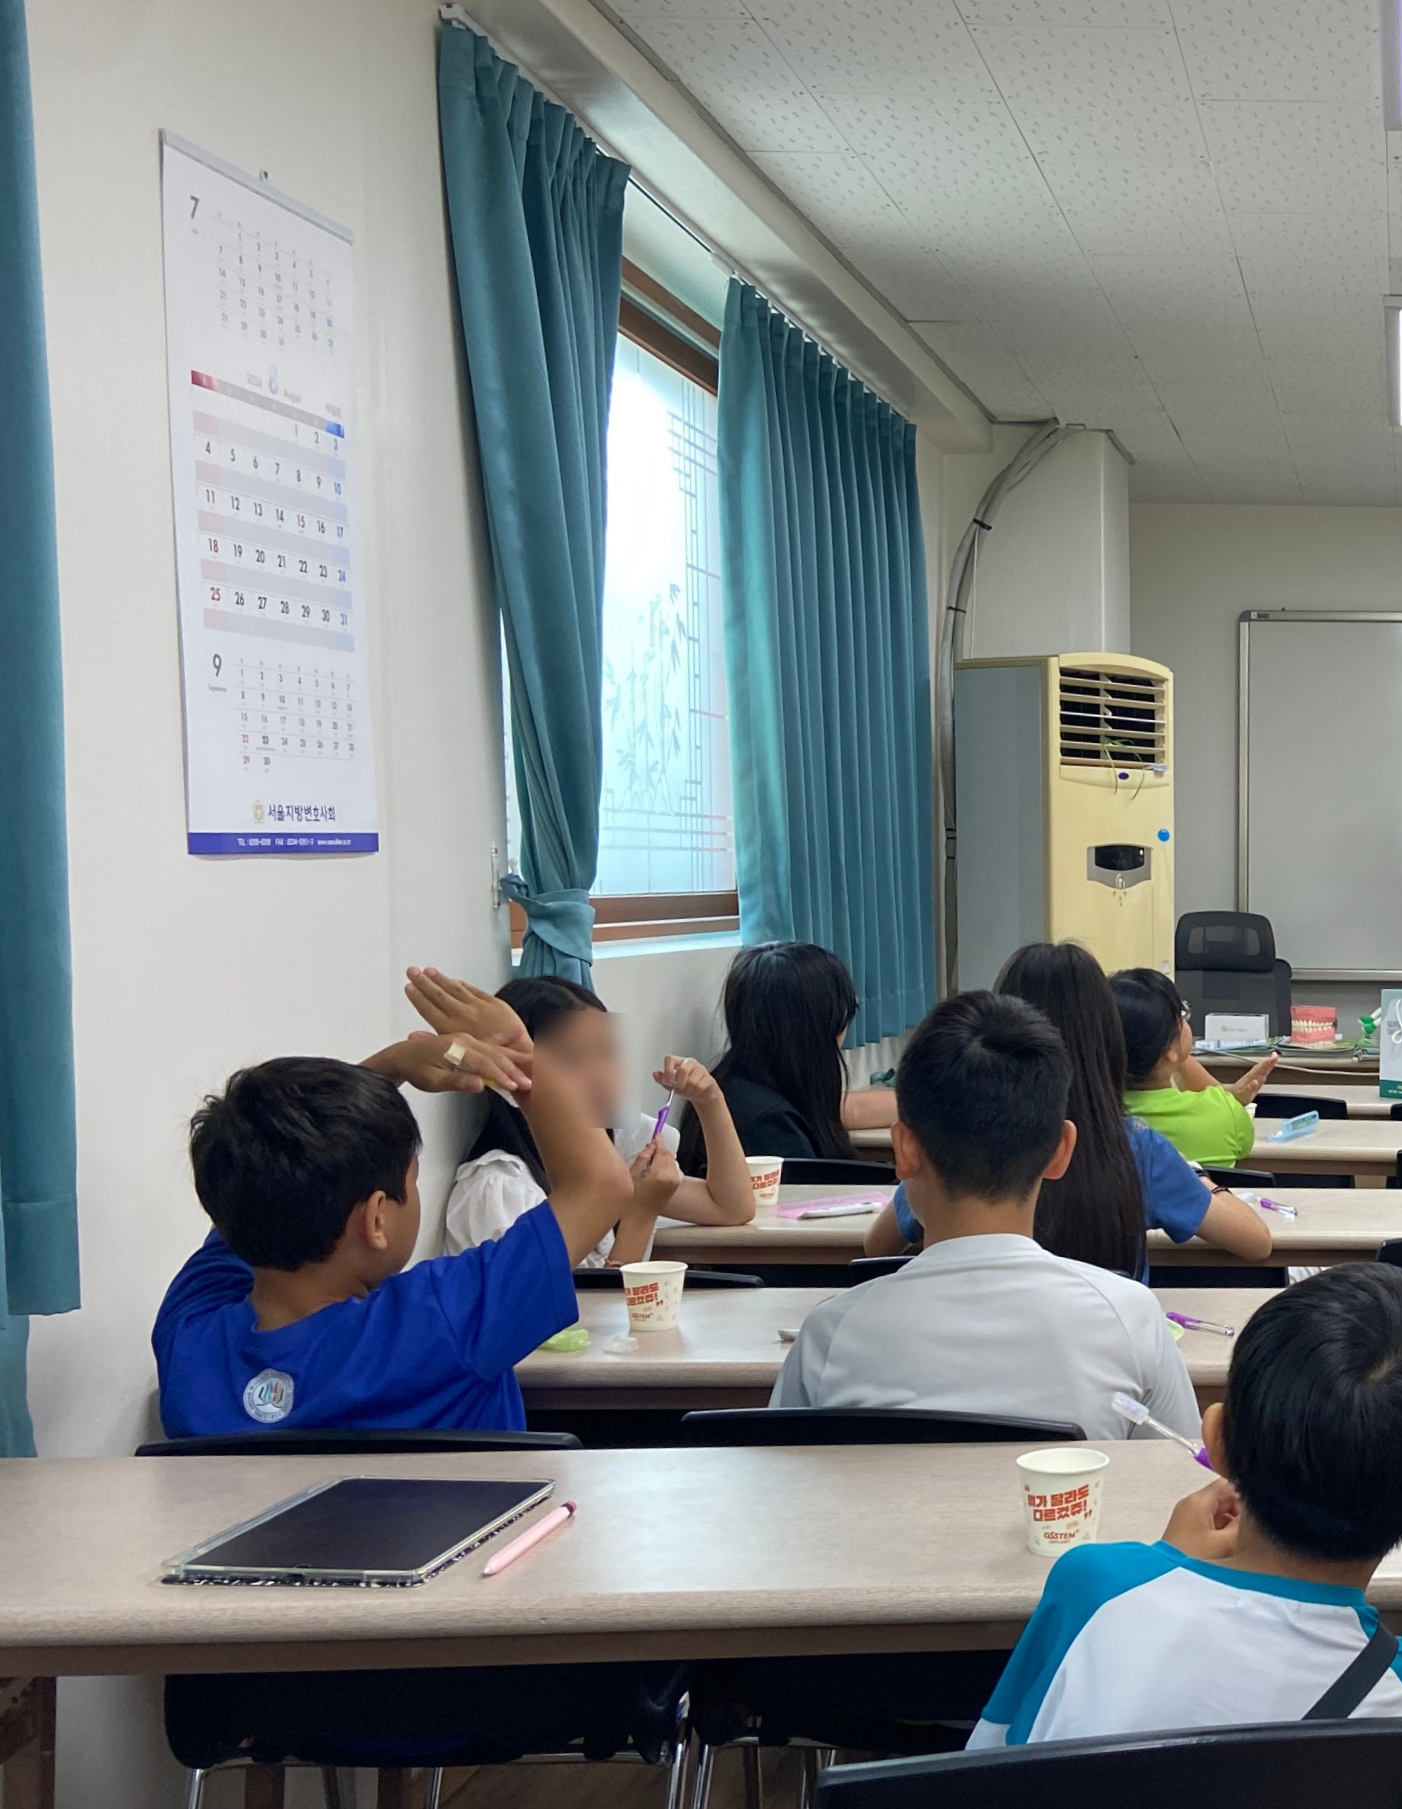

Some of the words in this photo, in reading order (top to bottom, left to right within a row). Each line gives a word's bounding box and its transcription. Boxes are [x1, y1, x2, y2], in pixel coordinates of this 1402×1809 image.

[190, 194, 200, 220] 7
[294, 424, 298, 437] 1
[314, 431, 319, 444] 2
[333, 438, 338, 451] 3
[205, 441, 211, 454] 4
[230, 449, 236, 462] 5
[253, 456, 258, 469] 6
[275, 463, 280, 475] 7
[296, 470, 301, 482] 8
[316, 476, 321, 489] 9
[334, 482, 342, 495] 10
[206, 489, 215, 504] 11
[231, 496, 240, 511] 12
[254, 502, 263, 516] 13
[275, 508, 284, 522] 14
[297, 515, 306, 528] 15
[317, 520, 326, 534] 16
[336, 526, 344, 538] 17
[208, 538, 219, 553] 18
[233, 544, 243, 558] 19
[256, 550, 265, 563] 20
[277, 555, 286, 568] 21
[299, 560, 308, 573] 22
[319, 565, 328, 578] 23
[338, 570, 346, 582] 24
[210, 587, 221, 601] 25
[235, 592, 244, 606] 26
[257, 597, 267, 610] 27
[280, 601, 289, 614] 28
[301, 605, 310, 618] 29
[321, 609, 330, 622] 30
[340, 613, 348, 626] 31
[212, 653, 222, 677] 9
[268, 805, 336, 822] 서울지방변호사회
[1051, 1484, 1089, 1507] 달라도
[1044, 1531, 1075, 1540] OSSTEM
